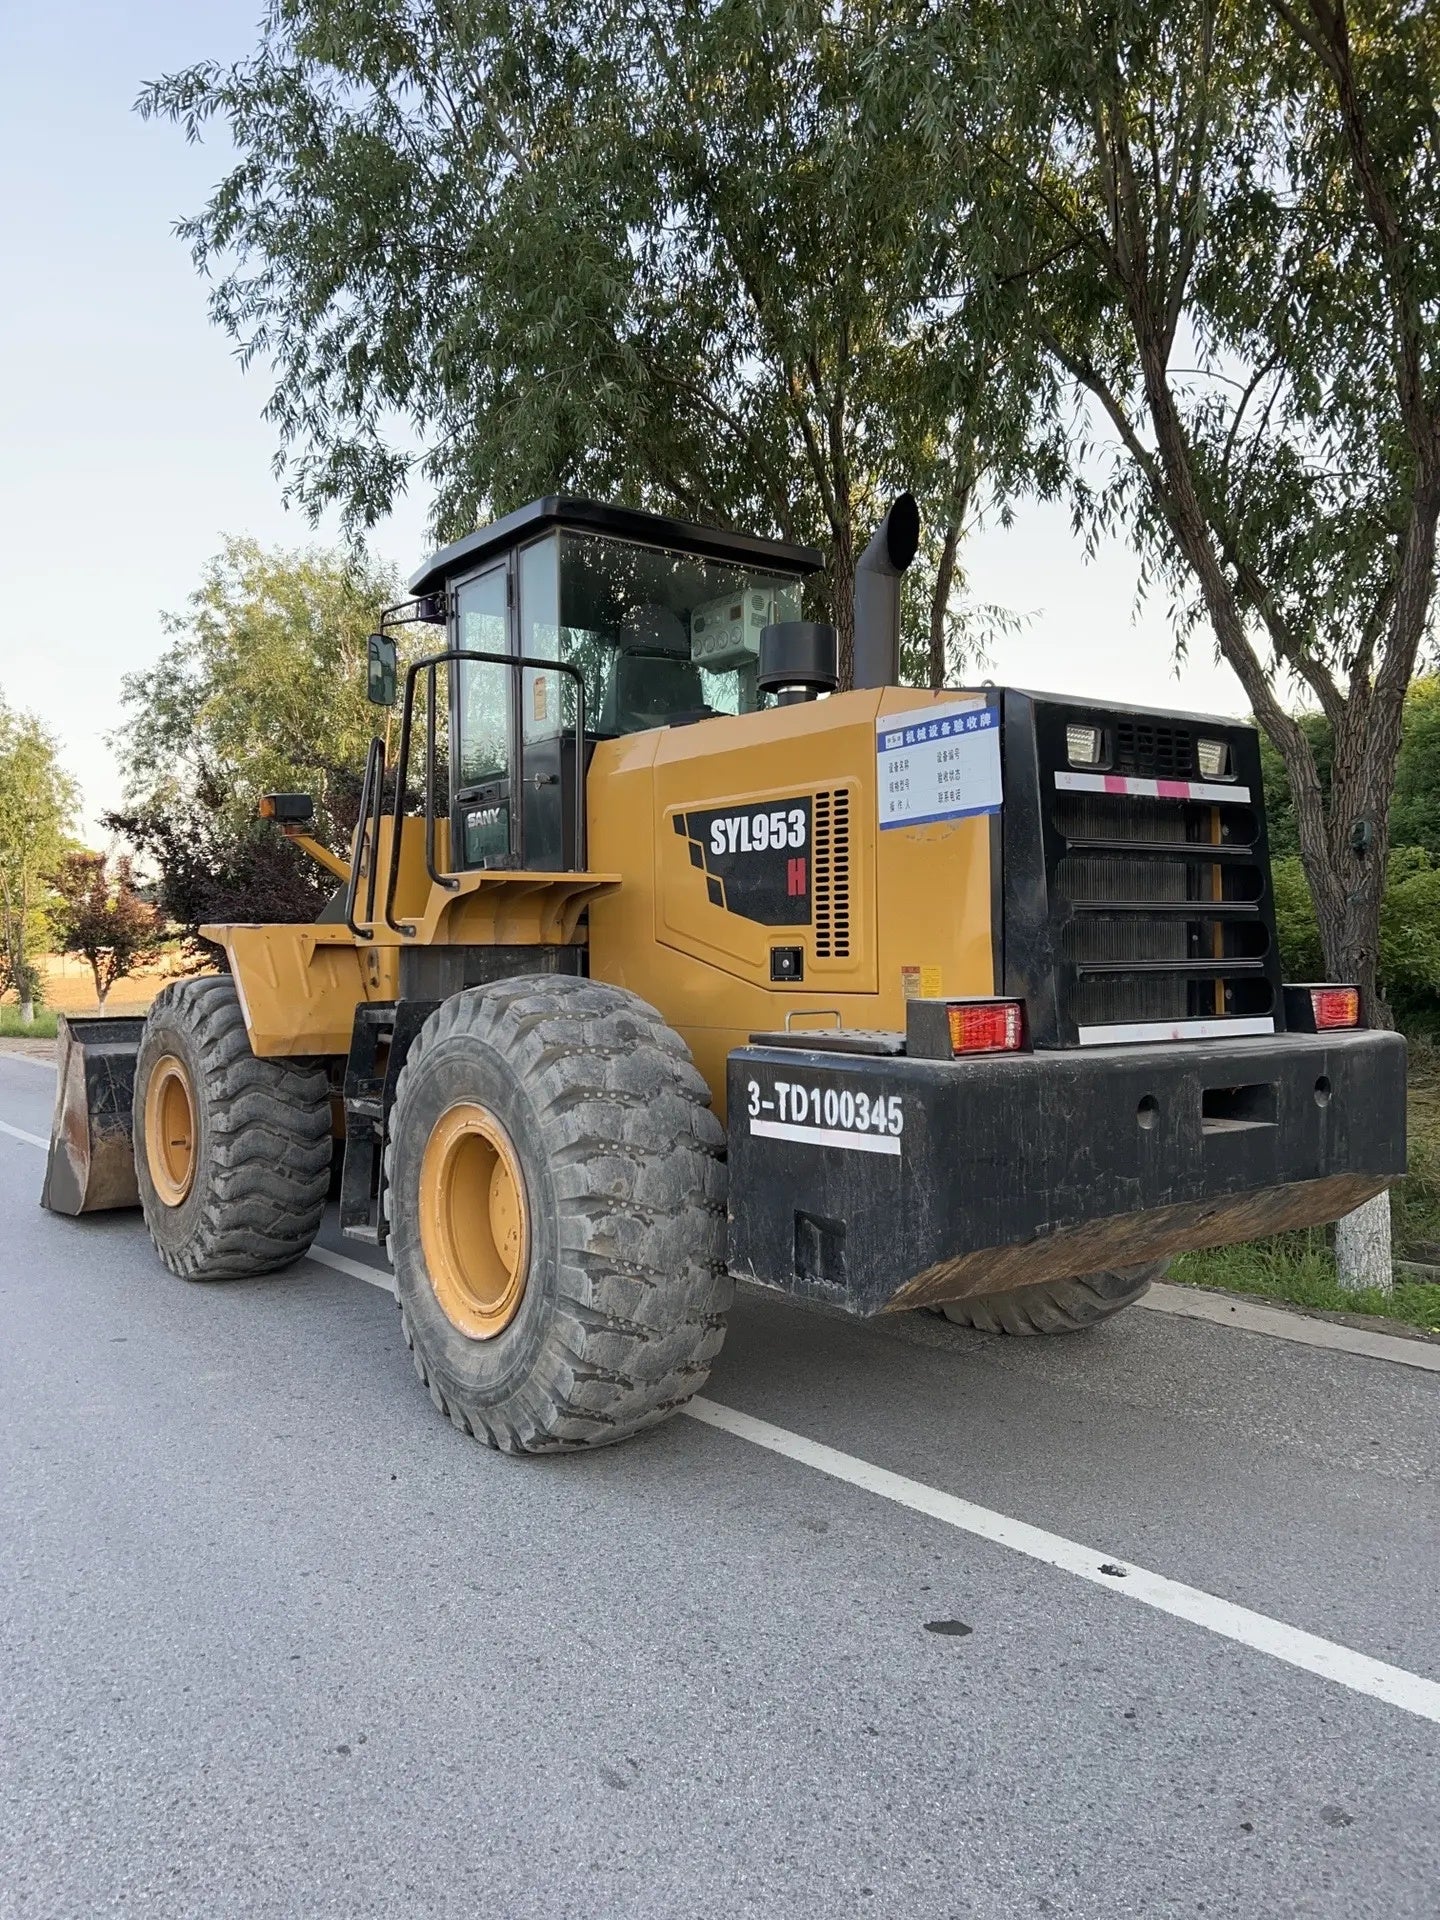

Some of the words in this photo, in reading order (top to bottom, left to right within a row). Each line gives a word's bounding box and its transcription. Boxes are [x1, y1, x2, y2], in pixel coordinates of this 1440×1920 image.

[906, 712, 992, 743] 机械设备验收牌
[467, 807, 500, 828] SANY
[710, 809, 806, 855] SYL953
[787, 857, 807, 896] H
[747, 1080, 904, 1135] 3-TD100345
